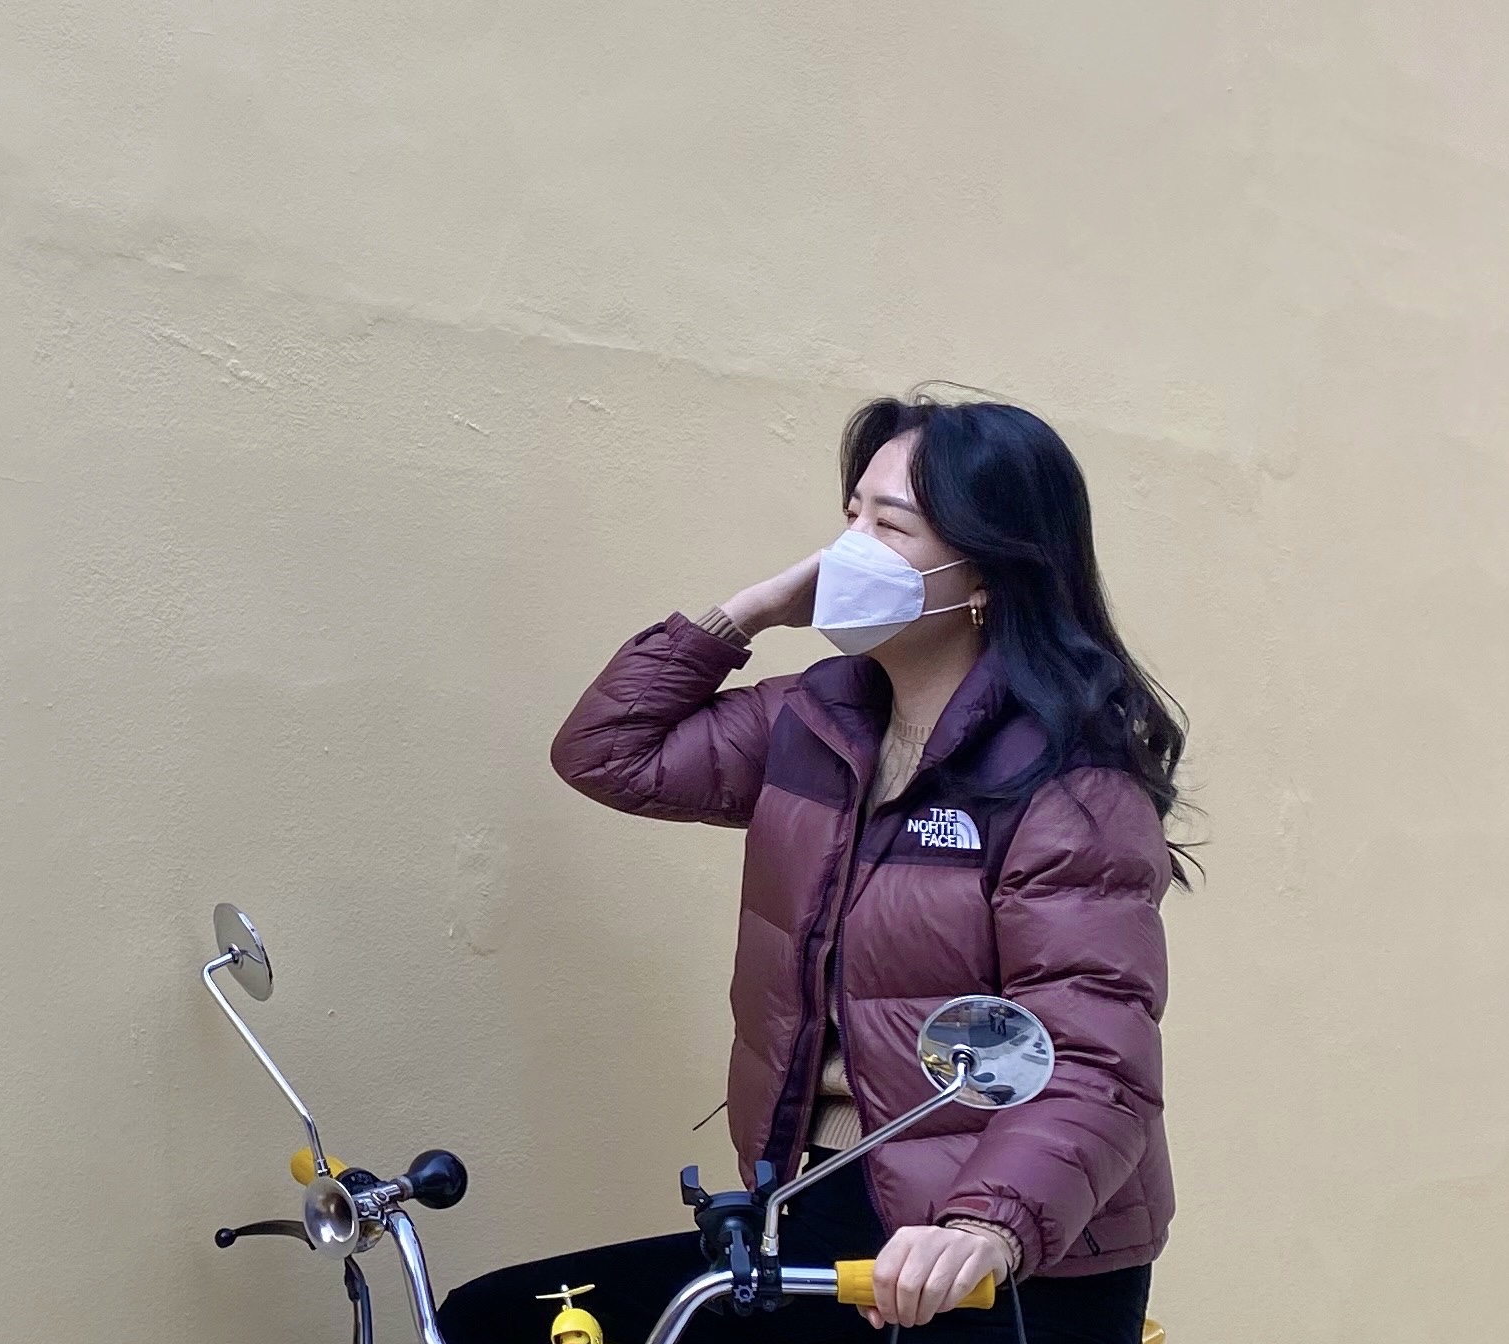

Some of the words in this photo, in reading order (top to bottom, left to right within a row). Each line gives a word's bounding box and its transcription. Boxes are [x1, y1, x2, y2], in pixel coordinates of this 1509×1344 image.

[930, 807, 957, 821] THE
[907, 819, 957, 835] NORTH
[921, 834, 957, 848] FACE
